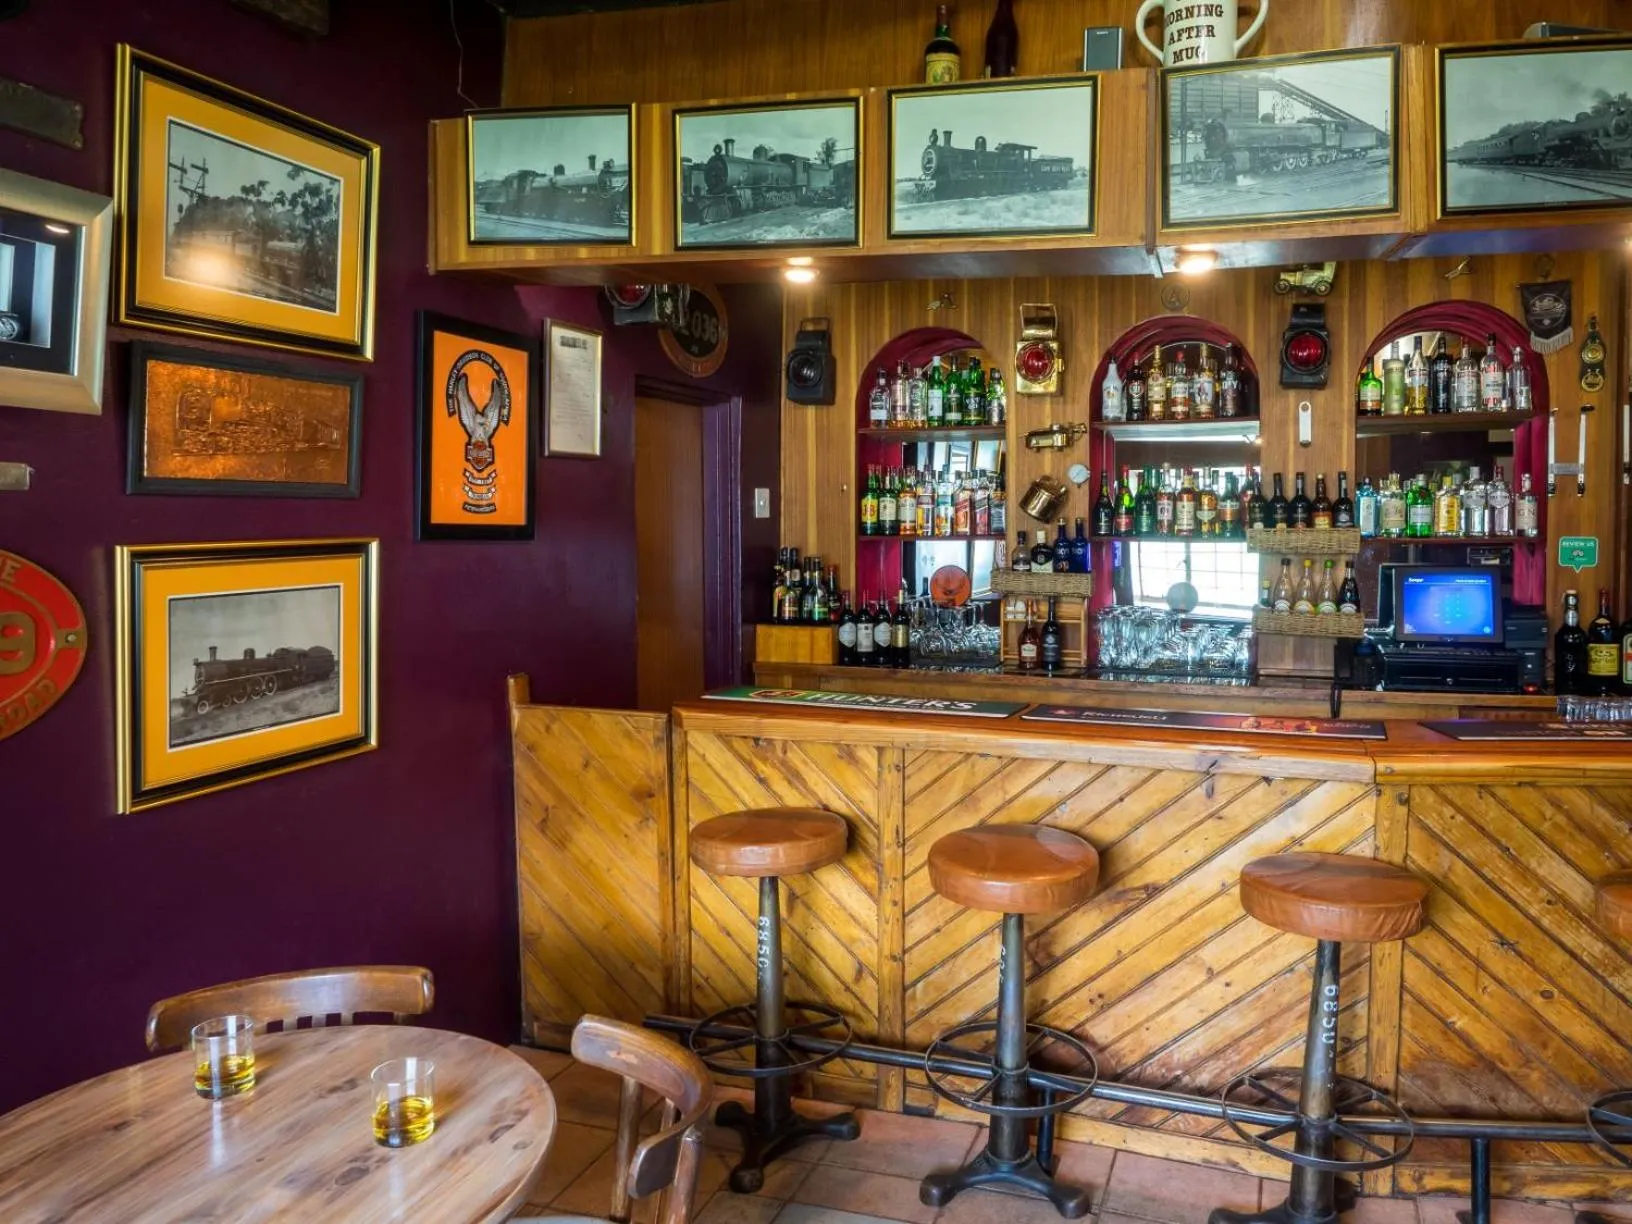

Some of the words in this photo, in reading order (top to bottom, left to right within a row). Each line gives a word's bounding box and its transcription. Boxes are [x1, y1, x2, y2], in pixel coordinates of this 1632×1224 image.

[1168, 25, 1216, 46] AFTER
[1173, 45, 1206, 64] MUG
[805, 693, 977, 710] HUNTER'S
